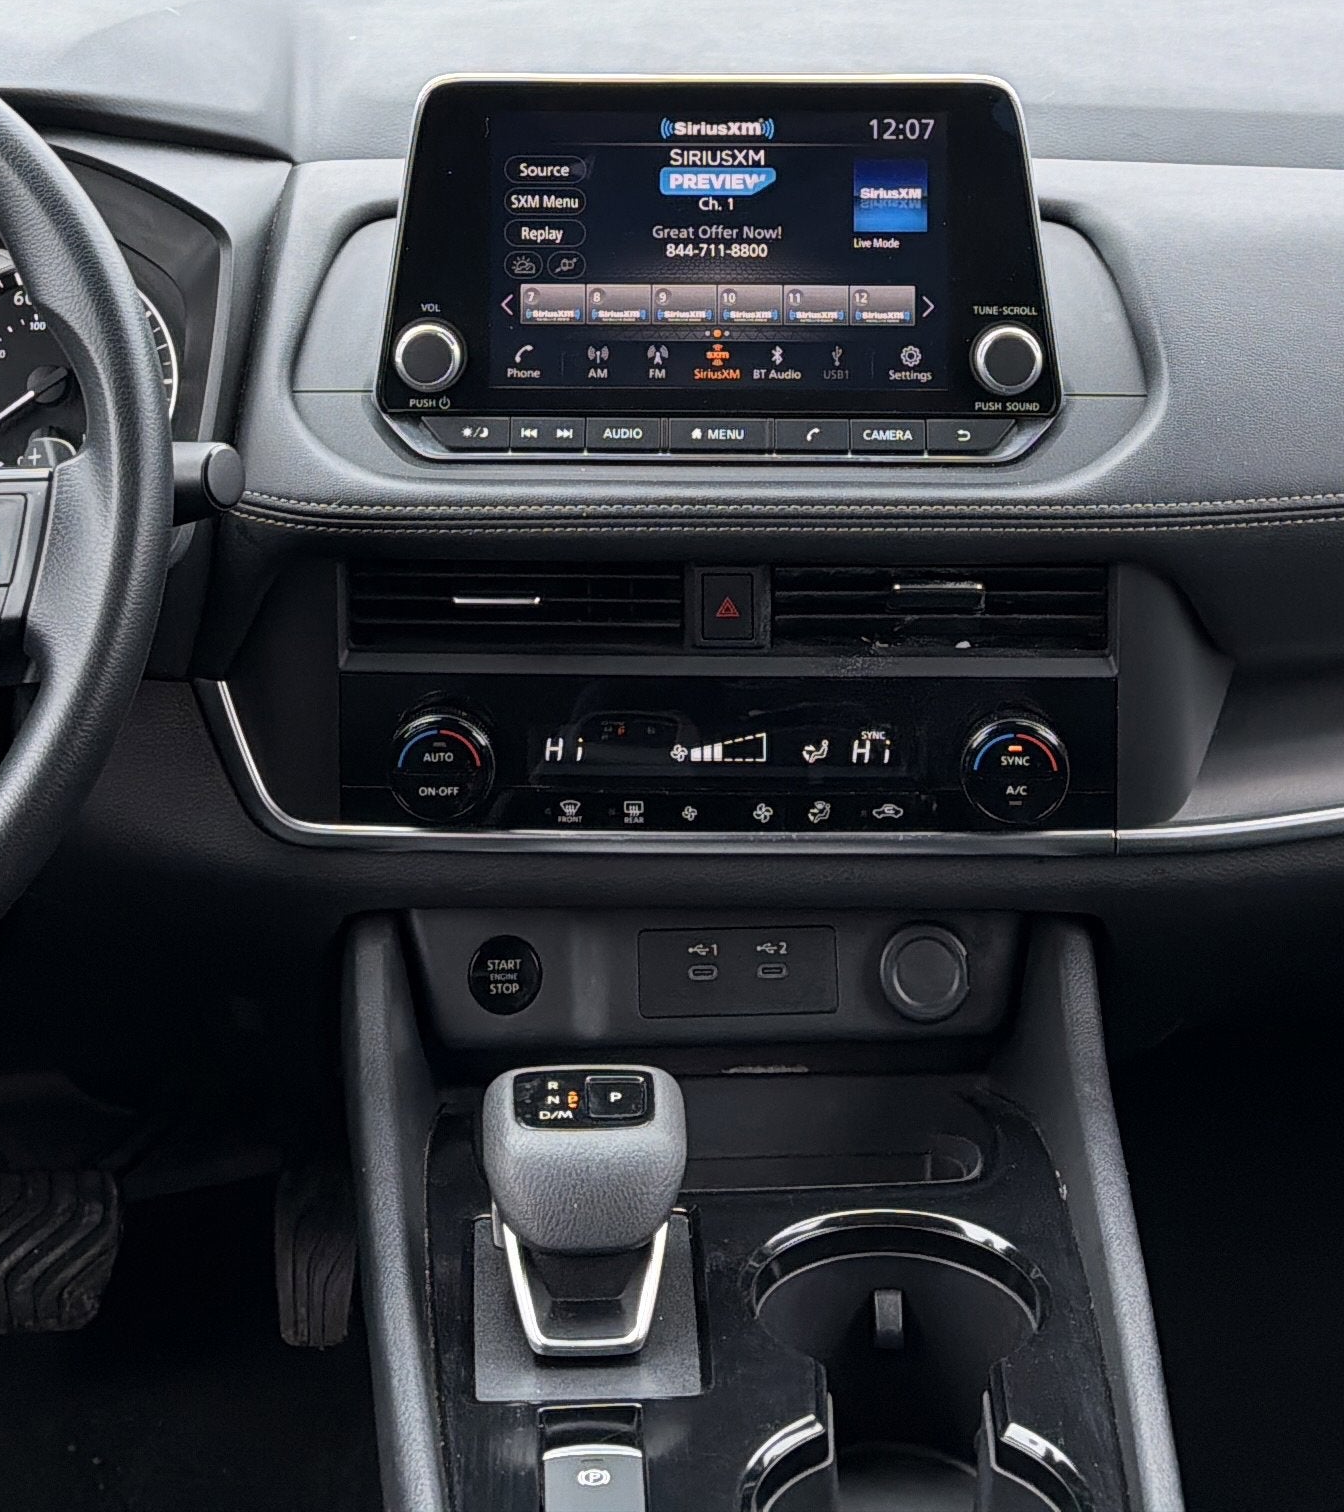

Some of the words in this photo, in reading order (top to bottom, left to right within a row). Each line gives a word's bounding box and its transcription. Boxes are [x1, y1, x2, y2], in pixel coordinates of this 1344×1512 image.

[869, 119, 935, 140] 12:07
[669, 149, 765, 166] SIRIUSXM
[519, 163, 570, 177] Source
[669, 173, 767, 190] PREVIEW
[860, 188, 922, 200] SiriusXM
[511, 194, 540, 208] SXM
[543, 195, 579, 208] Menu
[698, 197, 723, 211] Ch.
[727, 197, 735, 210] 1
[521, 226, 563, 243] Replay
[652, 225, 694, 239] Great
[698, 225, 738, 239] Offer
[743, 225, 782, 239] Now!
[853, 238, 872, 249] Live
[873, 238, 900, 249] Mode
[666, 243, 768, 258] 844-711-8800
[527, 292, 535, 302] 7
[593, 292, 601, 302] 8
[659, 292, 667, 303] 9
[722, 292, 737, 303] 10
[788, 293, 802, 303] 11
[854, 293, 869, 304] 12
[421, 303, 441, 313] VOL
[29, 321, 46, 331] 100
[507, 368, 541, 379] Phone
[588, 368, 608, 379] AM
[649, 368, 666, 379] FM
[694, 368, 741, 379] SiriusXM
[753, 370, 766, 380] BT
[769, 369, 802, 380] Audio
[824, 370, 849, 380] USB1
[888, 370, 933, 383] Settings
[409, 398, 436, 408] PUSH
[974, 401, 1002, 412] PUSH
[1006, 401, 1040, 412] SOUND
[603, 428, 643, 440] AUDIO
[707, 428, 744, 440] MENU
[862, 429, 913, 441] CAMERA
[861, 731, 886, 740] SYNC
[423, 752, 454, 763] AUTO
[1000, 756, 1031, 767] SYNC
[1006, 785, 1028, 796] A/C
[709, 944, 718, 956] 1
[779, 942, 788, 954] 2
[487, 958, 522, 971] START
[490, 973, 518, 981] ENGINE
[489, 983, 520, 995] STOP
[547, 1081, 559, 1090] R
[547, 1095, 560, 1105] N
[609, 1092, 623, 1103] P
[539, 1110, 574, 1120] D/M
